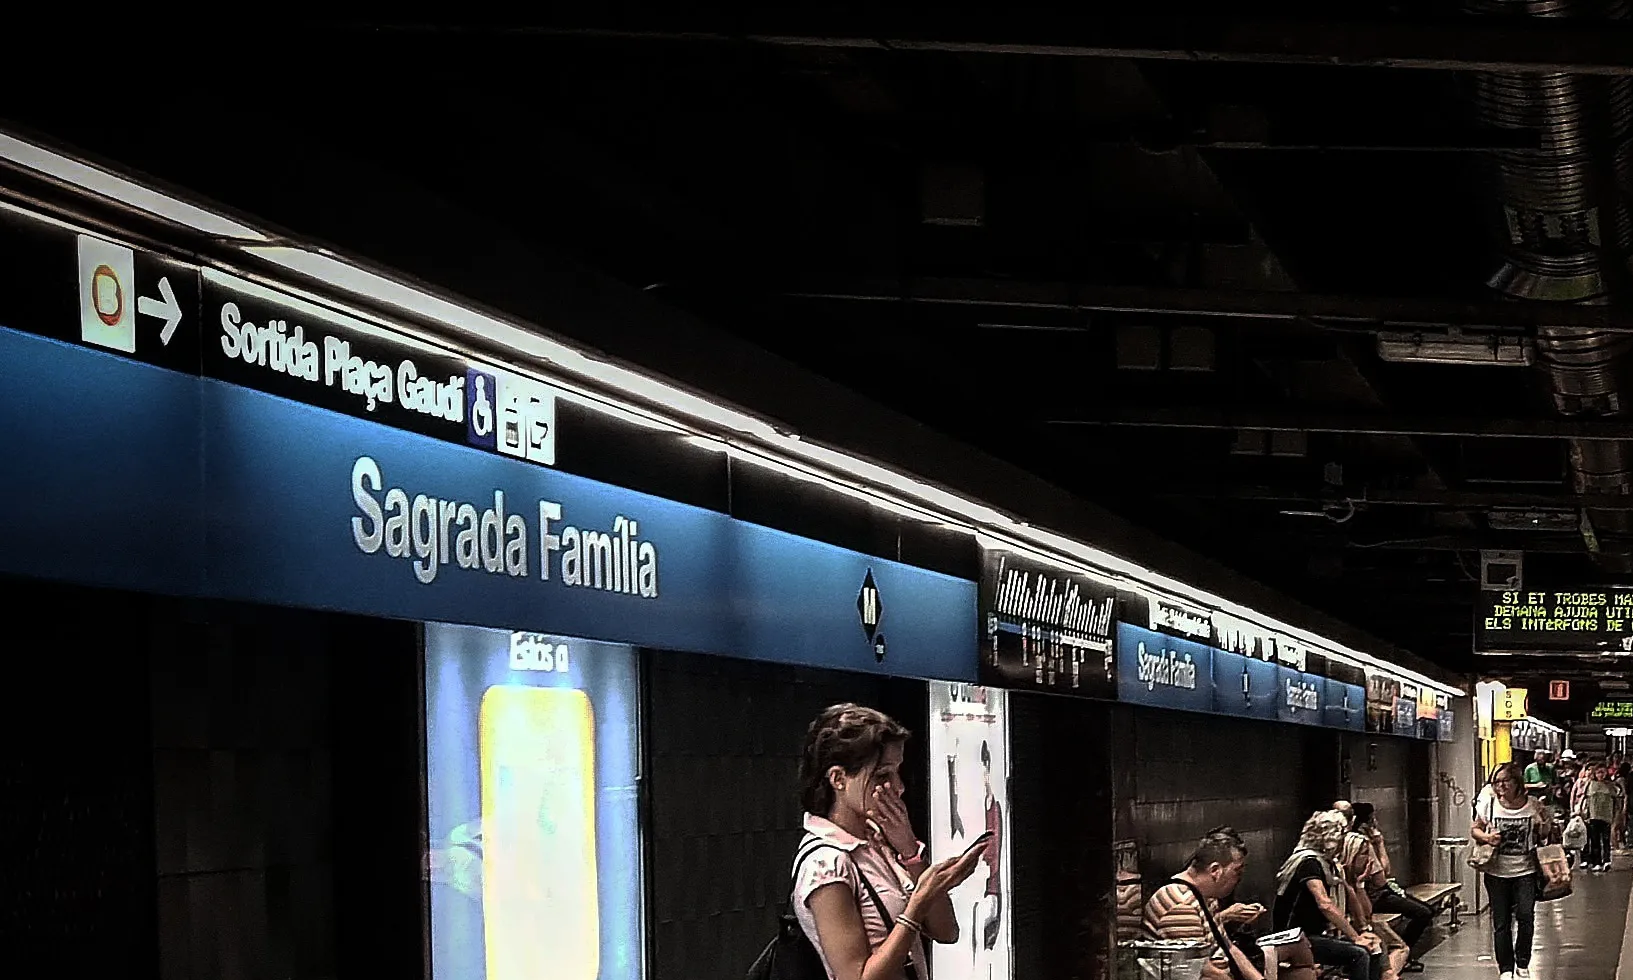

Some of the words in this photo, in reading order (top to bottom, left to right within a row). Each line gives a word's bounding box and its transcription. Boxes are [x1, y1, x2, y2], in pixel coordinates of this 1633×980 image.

[221, 302, 318, 382] Sortida
[324, 336, 393, 412] Plaça
[397, 360, 465, 423] Gaudí
[352, 456, 528, 584] Sagrada
[539, 500, 658, 599] Família
[1502, 592, 1519, 605] SI
[1528, 592, 1546, 605] ET
[1554, 592, 1606, 606] TROBES
[1494, 605, 1546, 617] DEMANA
[1554, 606, 1598, 618] AJUDA
[1485, 617, 1512, 630] ELS
[1521, 618, 1598, 631] INTERFONS
[1606, 619, 1624, 632] DE
